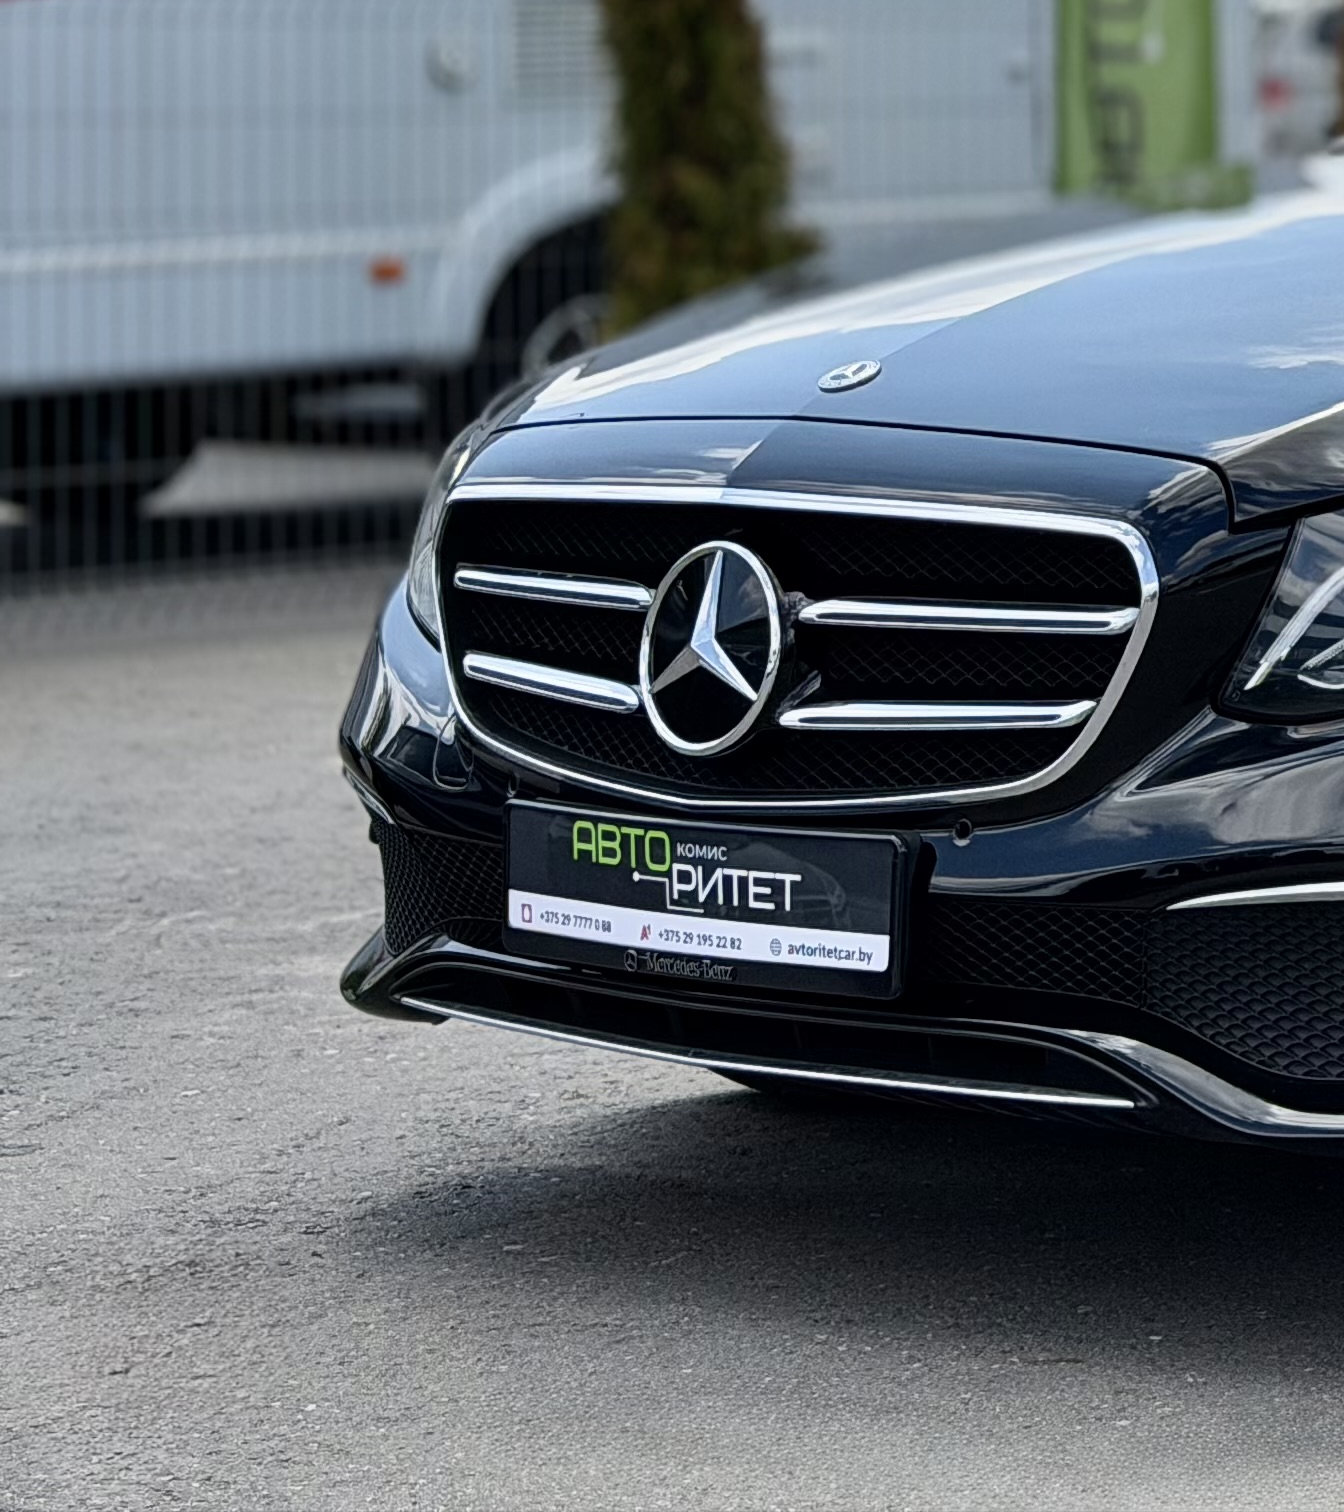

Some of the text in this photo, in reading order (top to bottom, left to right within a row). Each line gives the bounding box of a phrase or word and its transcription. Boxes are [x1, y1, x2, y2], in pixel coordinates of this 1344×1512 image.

[572, 820, 671, 872] АВТО
[676, 842, 727, 861] КОМИС
[672, 863, 802, 911] РИТЕТ
[540, 911, 559, 925] +375
[561, 913, 571, 926] 29
[573, 916, 593, 930] 7777
[658, 928, 742, 951] +375 29 195 22 82
[787, 943, 874, 965] avtoritetcar.by
